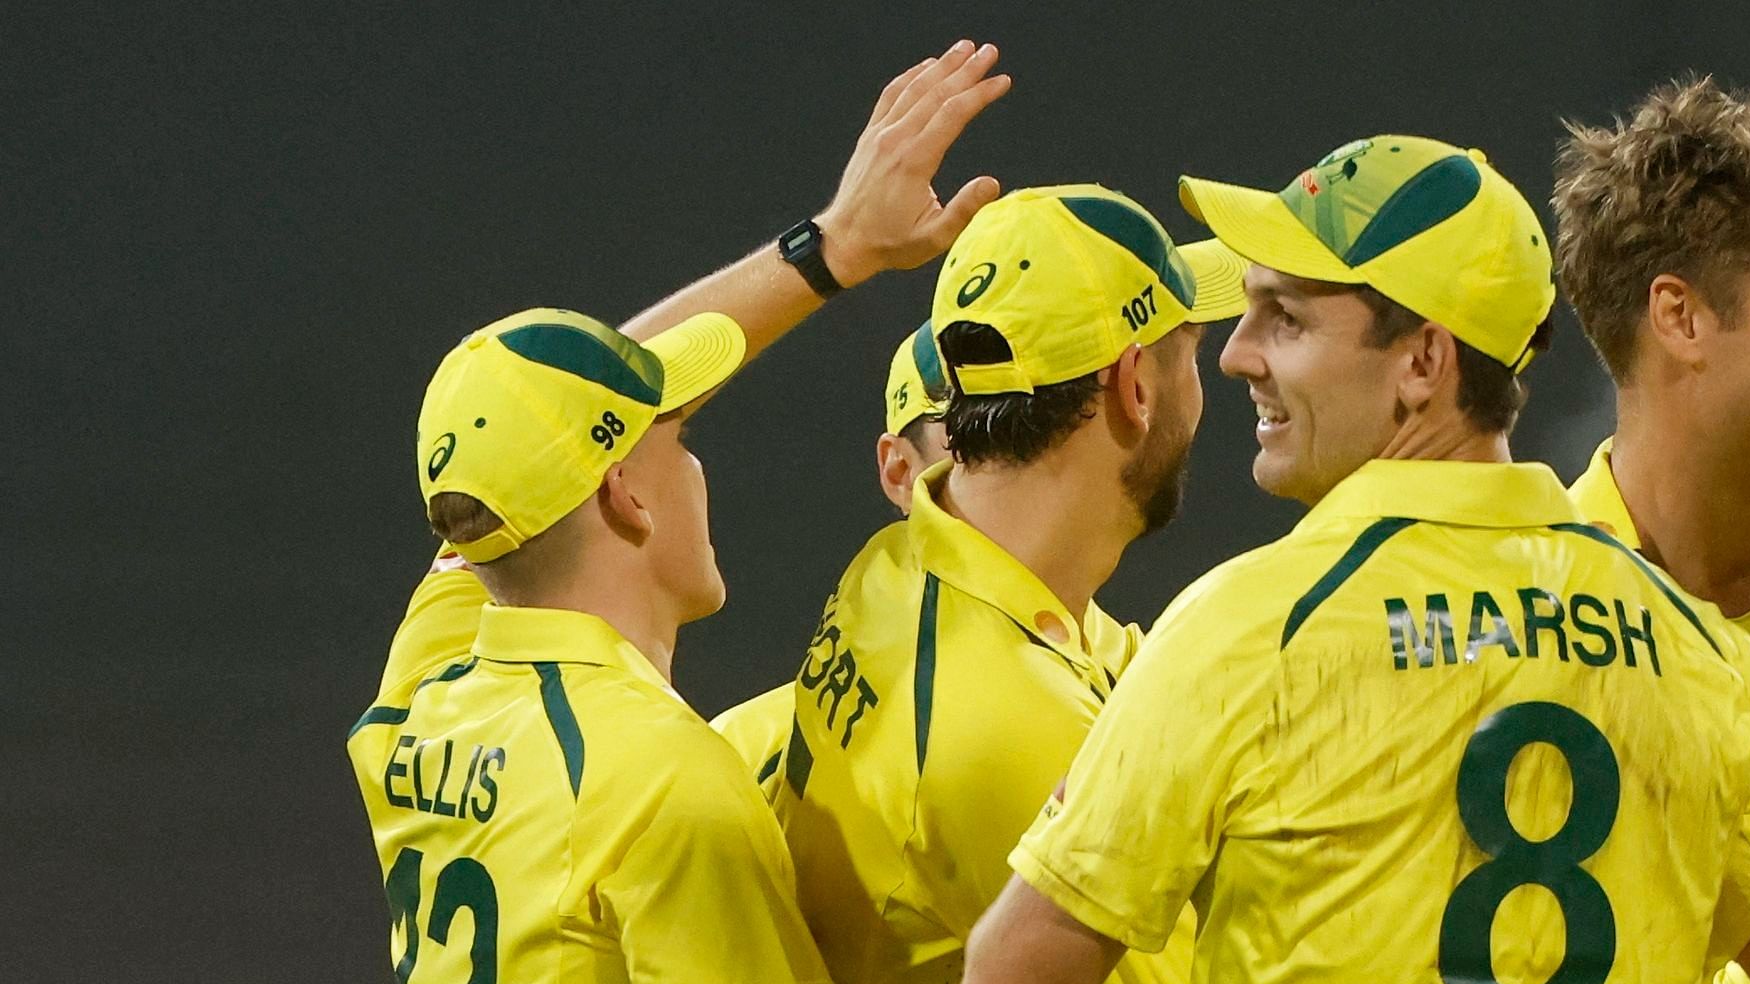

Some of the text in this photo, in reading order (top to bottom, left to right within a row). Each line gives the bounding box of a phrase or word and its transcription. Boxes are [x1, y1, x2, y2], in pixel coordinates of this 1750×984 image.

[1122, 284, 1157, 332] 107
[591, 410, 625, 451] 98
[1384, 587, 1662, 677] MARSH
[386, 735, 506, 823] ELLIS
